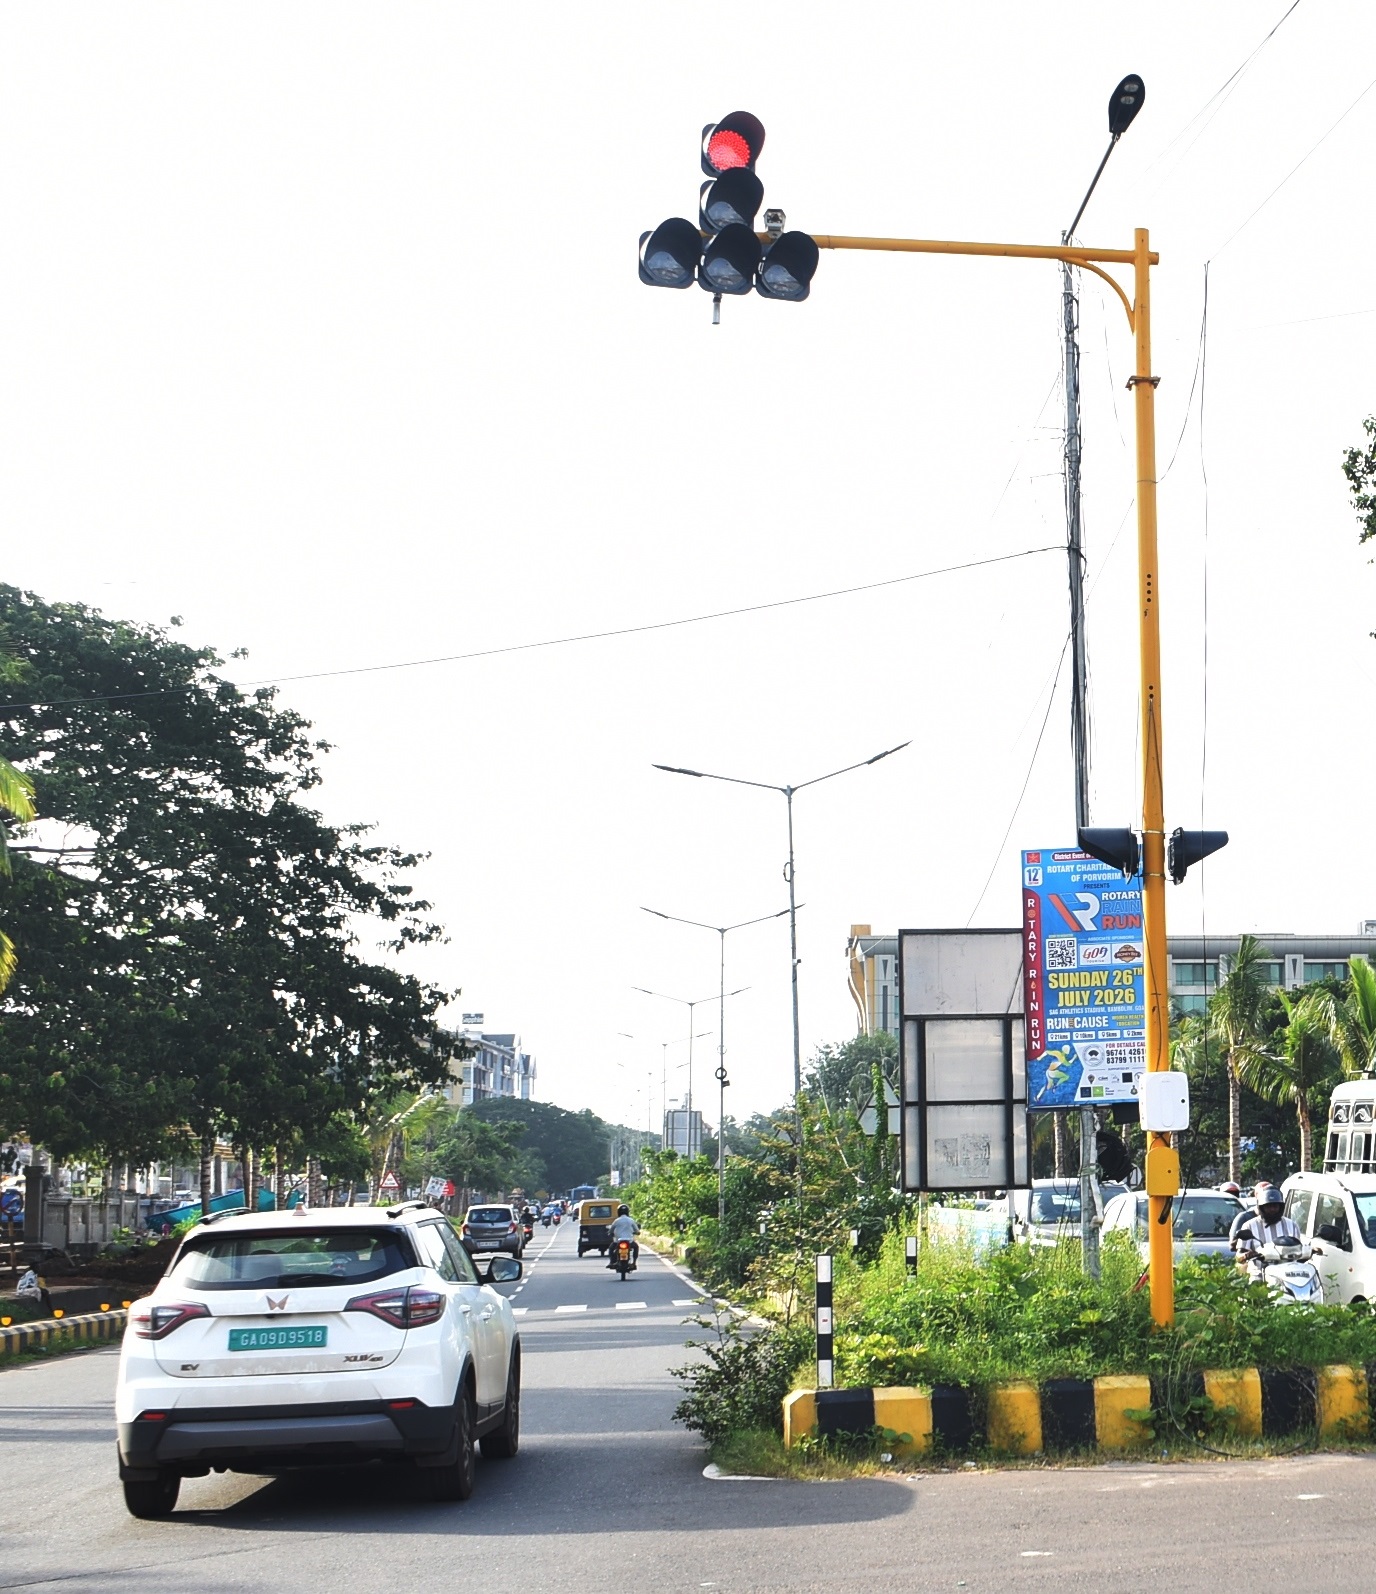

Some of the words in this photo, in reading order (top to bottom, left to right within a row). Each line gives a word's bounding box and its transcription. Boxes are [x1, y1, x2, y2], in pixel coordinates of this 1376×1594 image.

[1047, 865, 1074, 873] ROTARY
[1071, 874, 1080, 882] OF
[1083, 872, 1121, 881] PORVORIM
[1102, 891, 1141, 900] ROTARY
[1101, 901, 1141, 914] RAIN
[1102, 915, 1140, 930] RUN
[1048, 971, 1109, 989] SUNDAY
[1058, 990, 1090, 1007] JULY
[1094, 988, 1135, 1005] 2026
[1046, 1018, 1069, 1030] RUN
[1074, 1016, 1109, 1028] CAUSE
[1031, 1018, 1041, 1050] RUN
[1128, 1048, 1146, 1056] 4261
[240, 1330, 323, 1346] GA09D9518
[180, 1363, 200, 1371] EV
